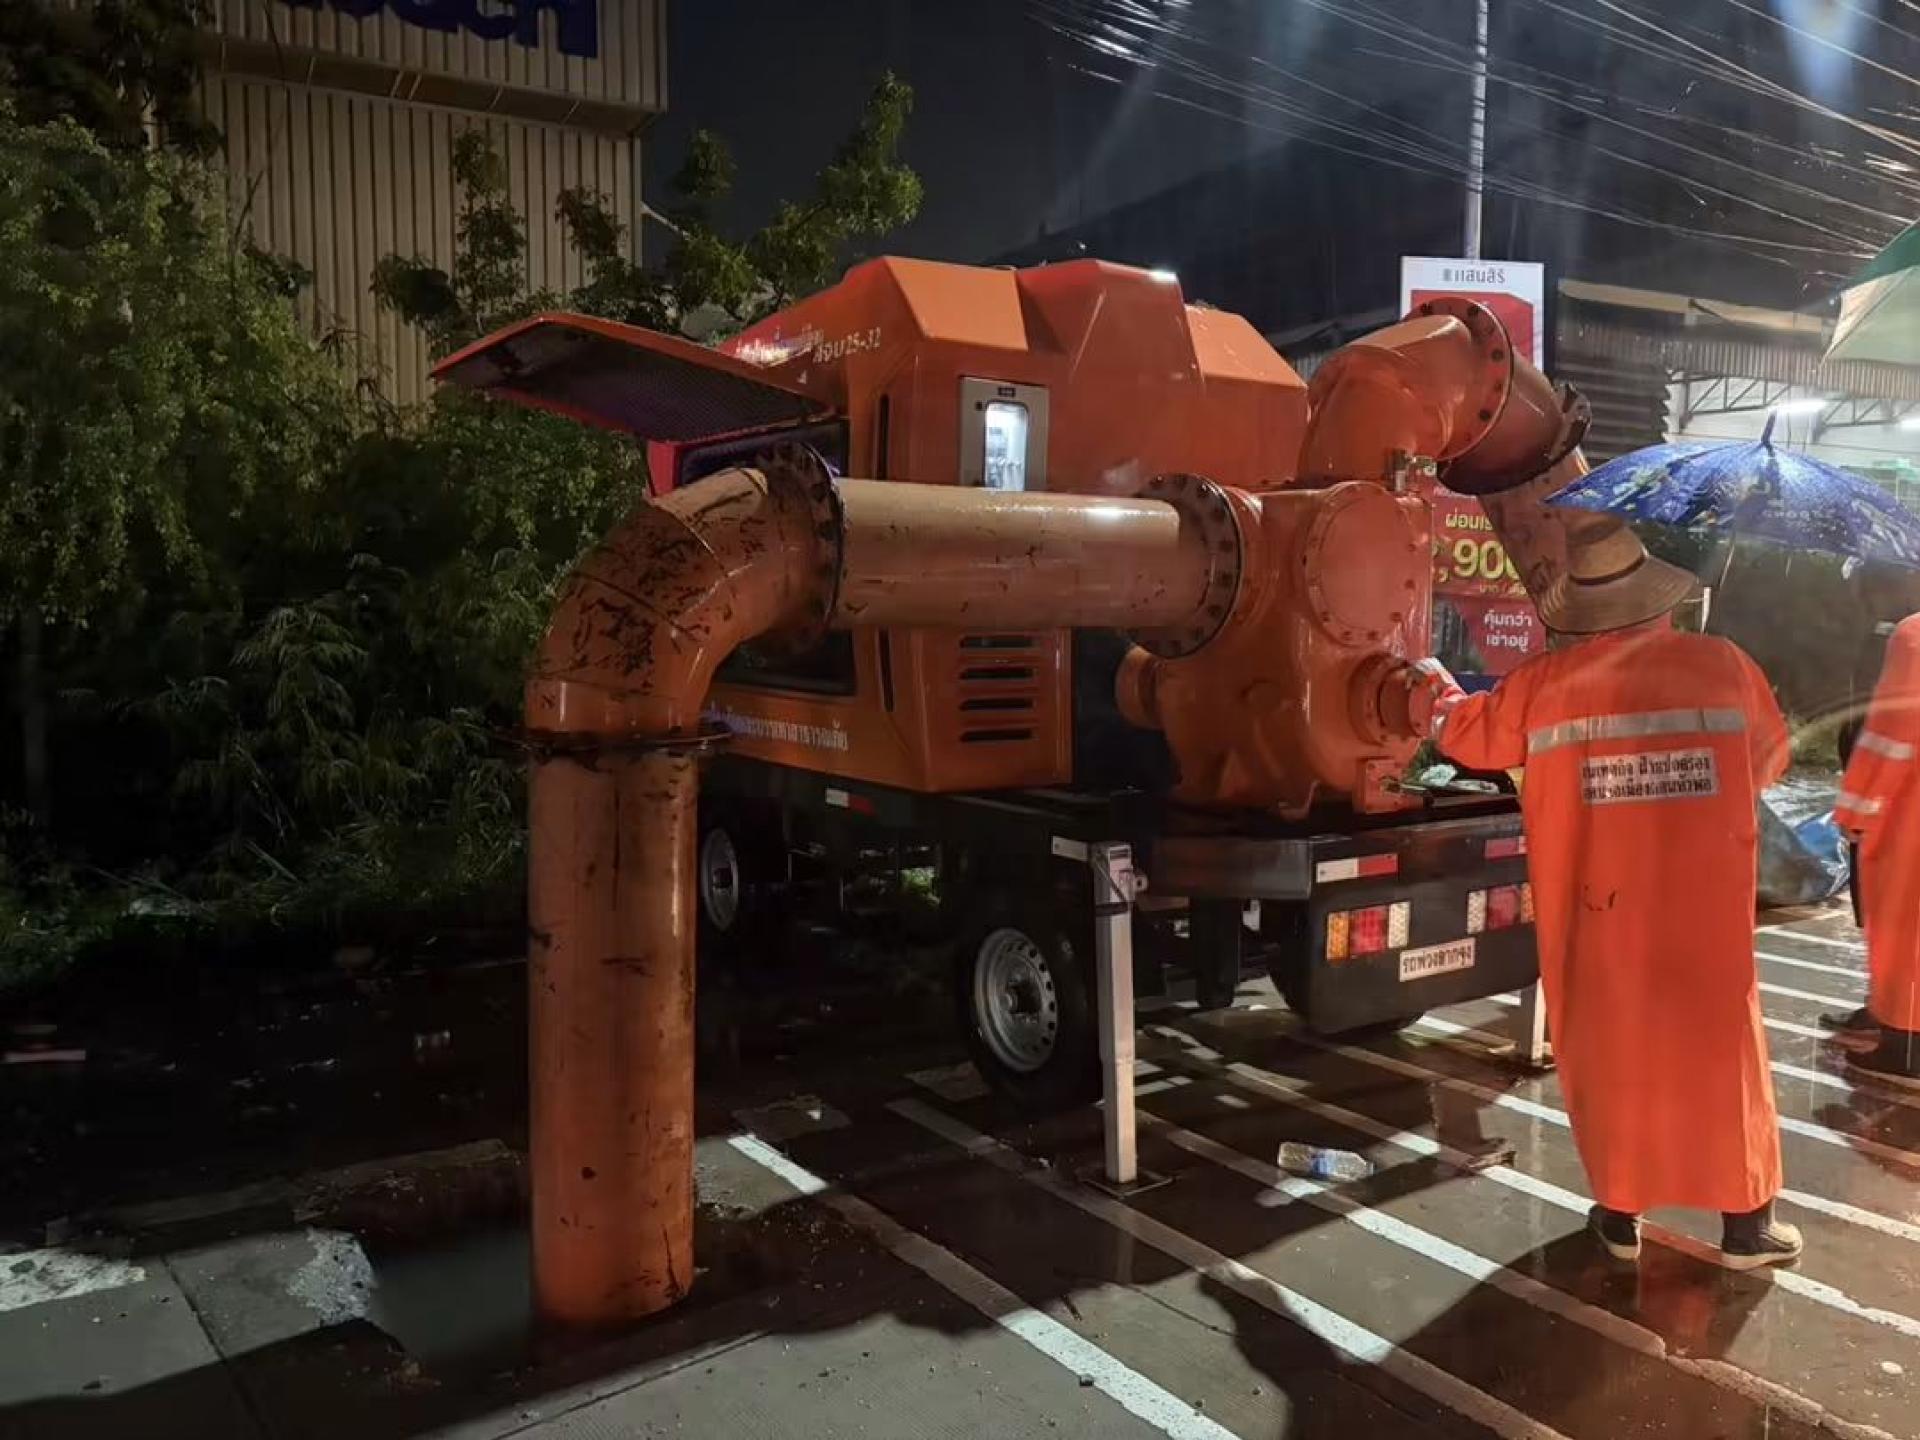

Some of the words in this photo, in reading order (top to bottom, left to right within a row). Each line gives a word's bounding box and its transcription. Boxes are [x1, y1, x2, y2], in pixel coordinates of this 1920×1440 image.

[1454, 267, 1506, 283] แสนสิริ
[1445, 506, 1494, 531] ผ่อนเร
[1483, 608, 1533, 631] คุ้มกว่า
[1486, 629, 1529, 653] เช่าอยู่
